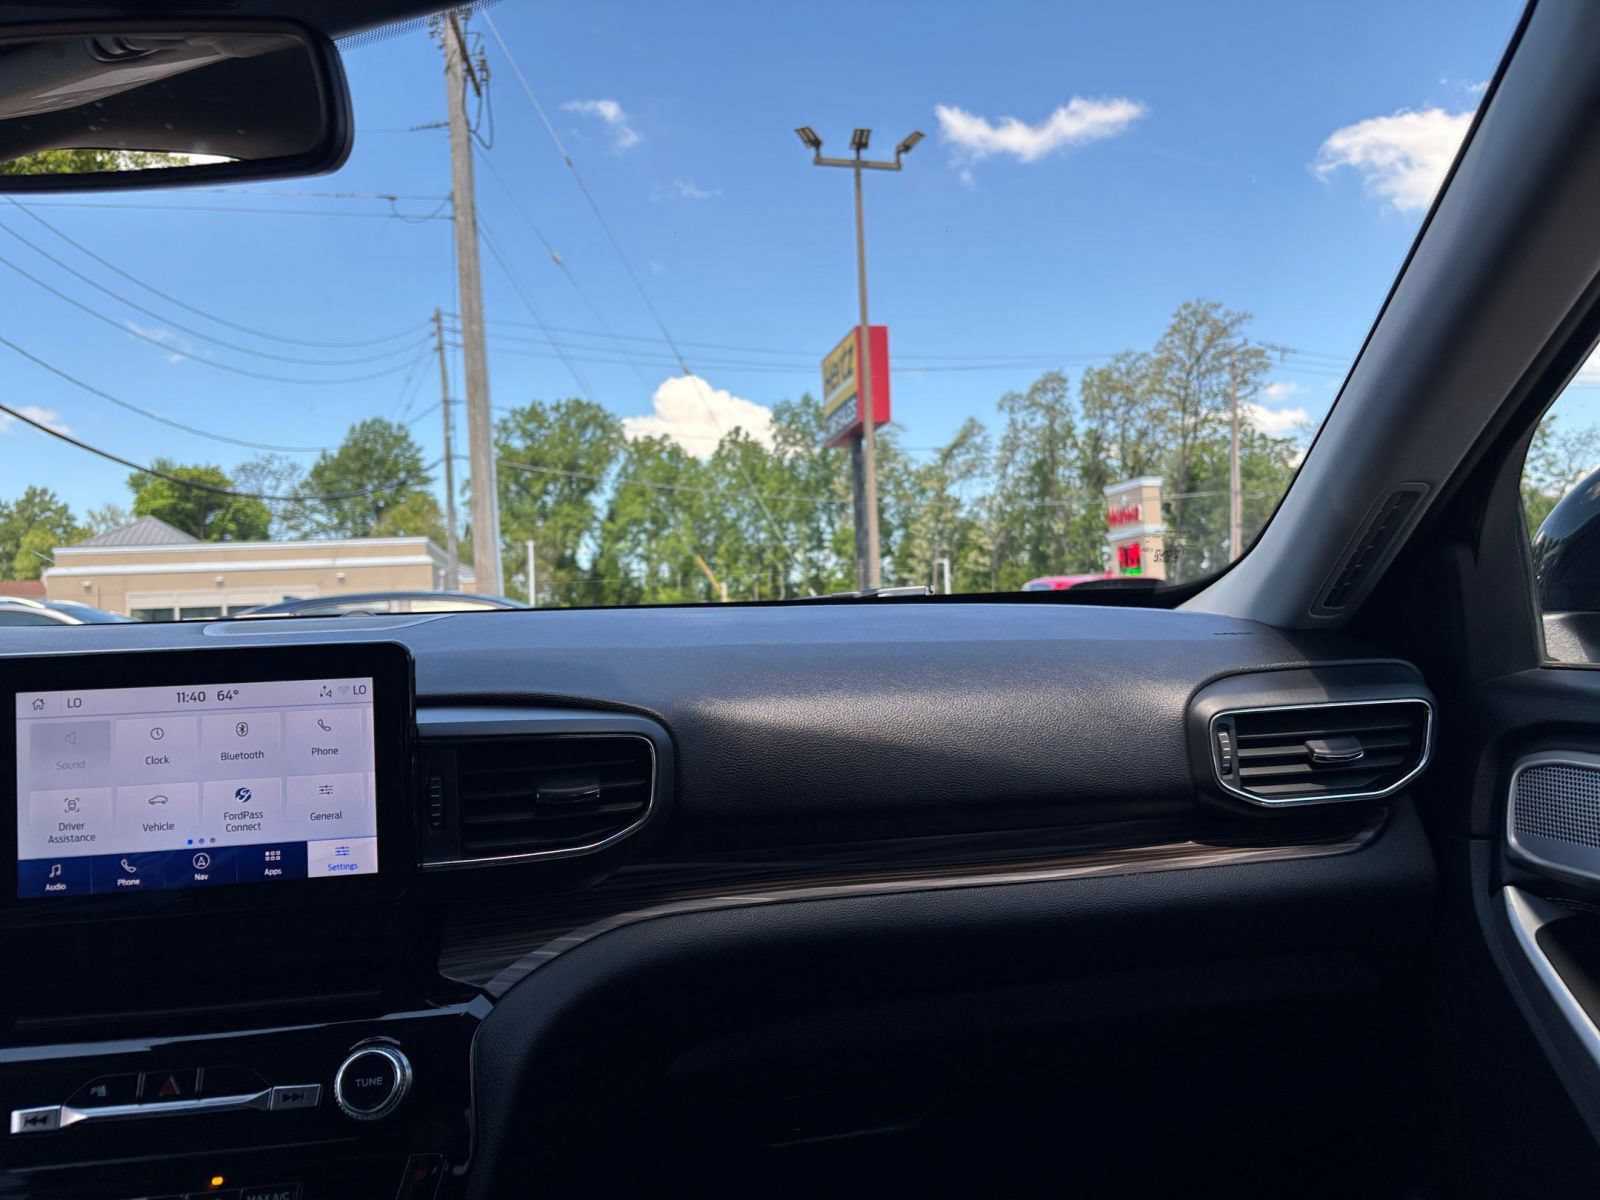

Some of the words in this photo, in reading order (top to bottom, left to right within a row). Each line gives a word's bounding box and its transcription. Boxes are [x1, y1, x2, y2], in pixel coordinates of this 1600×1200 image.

[176, 690, 206, 703] 11:40
[216, 689, 239, 702] 64°
[353, 684, 367, 696] LO
[67, 697, 82, 709] LO
[220, 749, 264, 762] Bluetooth
[311, 745, 339, 757] Phone
[56, 759, 85, 771] Sound
[145, 754, 170, 766] Clock
[223, 810, 264, 822] FordPass
[310, 810, 343, 822] General
[58, 821, 85, 832] Driver
[142, 820, 175, 832] Vehicle
[225, 821, 262, 833] Connect
[48, 832, 96, 844] Assistance
[264, 867, 283, 877] Apps
[327, 861, 359, 873] Settings
[117, 877, 141, 887] Phone
[194, 872, 209, 882] Nav
[45, 882, 67, 892] Audio
[355, 1076, 384, 1088] TUNE
